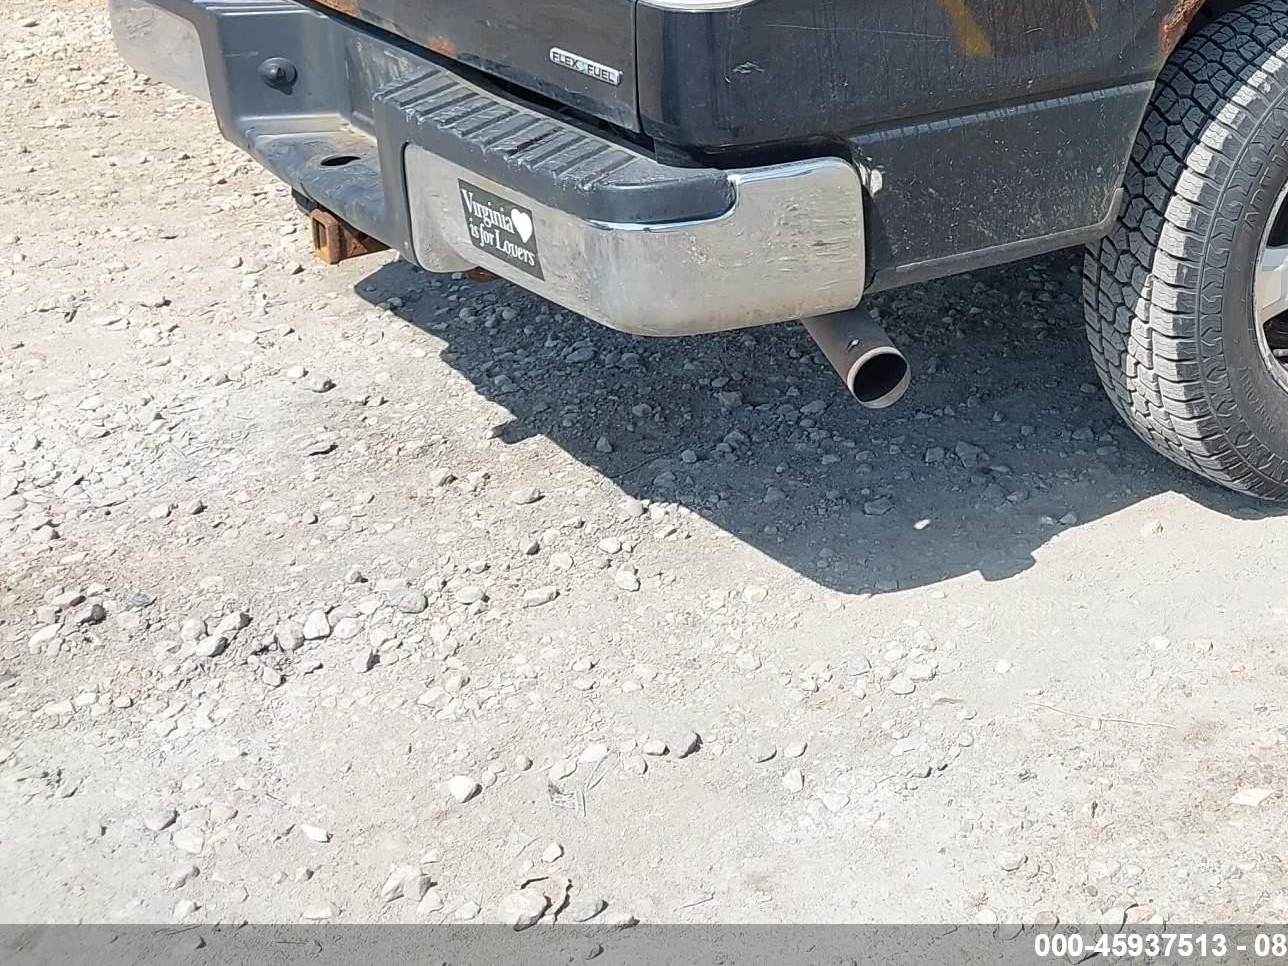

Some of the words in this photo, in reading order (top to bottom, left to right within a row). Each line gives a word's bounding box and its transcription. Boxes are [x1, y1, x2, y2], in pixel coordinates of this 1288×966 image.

[551, 50, 578, 71] FLEX
[586, 63, 616, 83] FUEL
[461, 188, 516, 234] Virginia
[469, 217, 480, 239] is
[480, 223, 495, 247] for
[494, 229, 536, 266] Lovers
